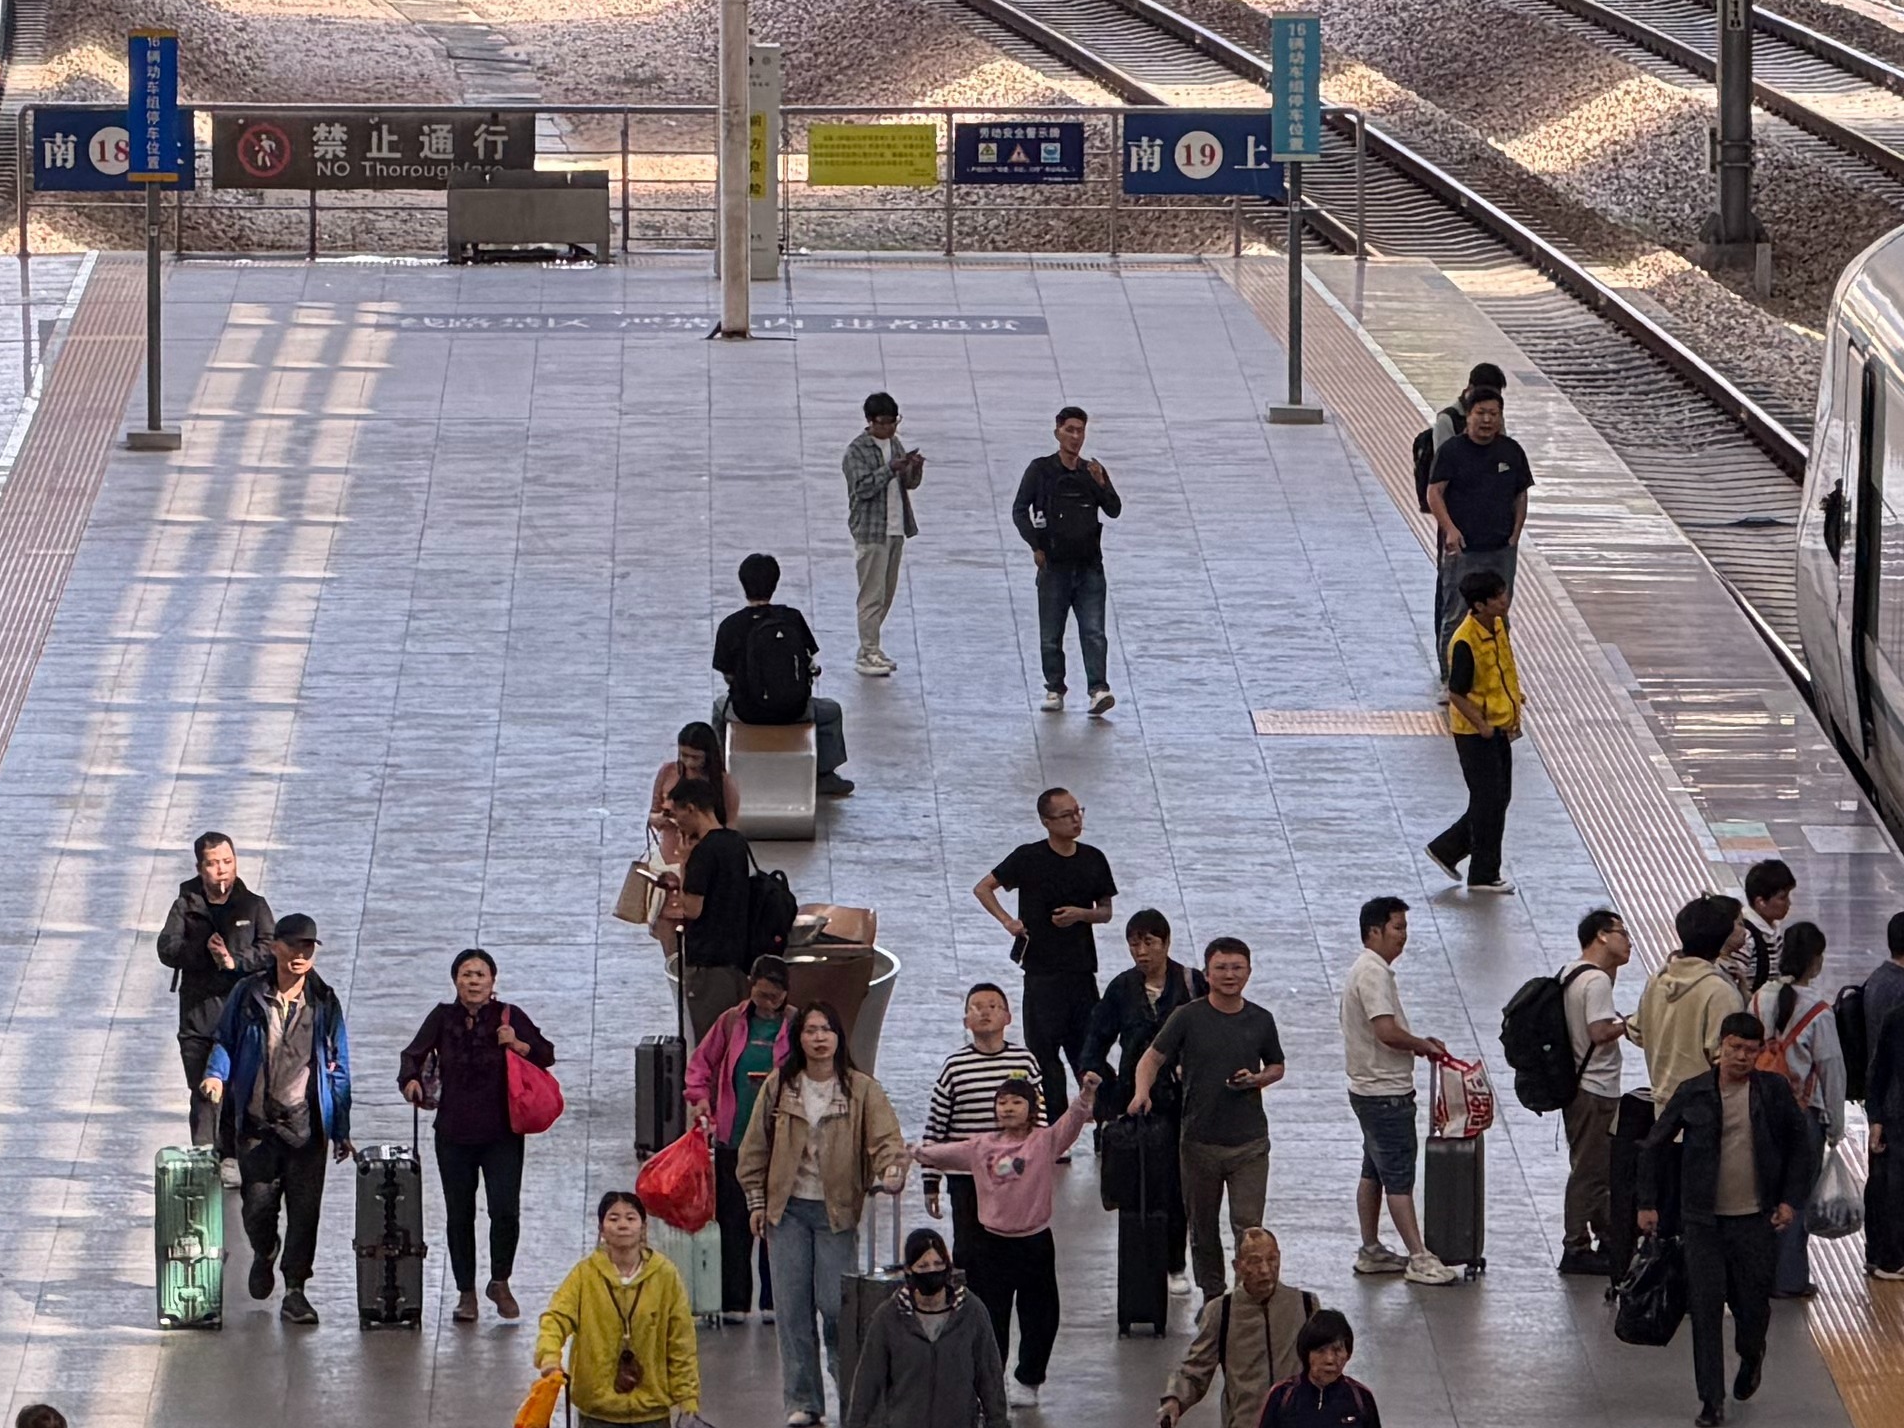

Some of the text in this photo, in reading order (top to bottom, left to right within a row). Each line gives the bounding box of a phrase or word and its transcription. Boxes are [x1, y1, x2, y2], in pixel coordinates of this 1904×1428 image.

[41, 132, 130, 170] 南 18
[312, 123, 509, 160] 禁止通行
[1127, 135, 1271, 173] 南 19 上
[316, 162, 350, 177] NO
